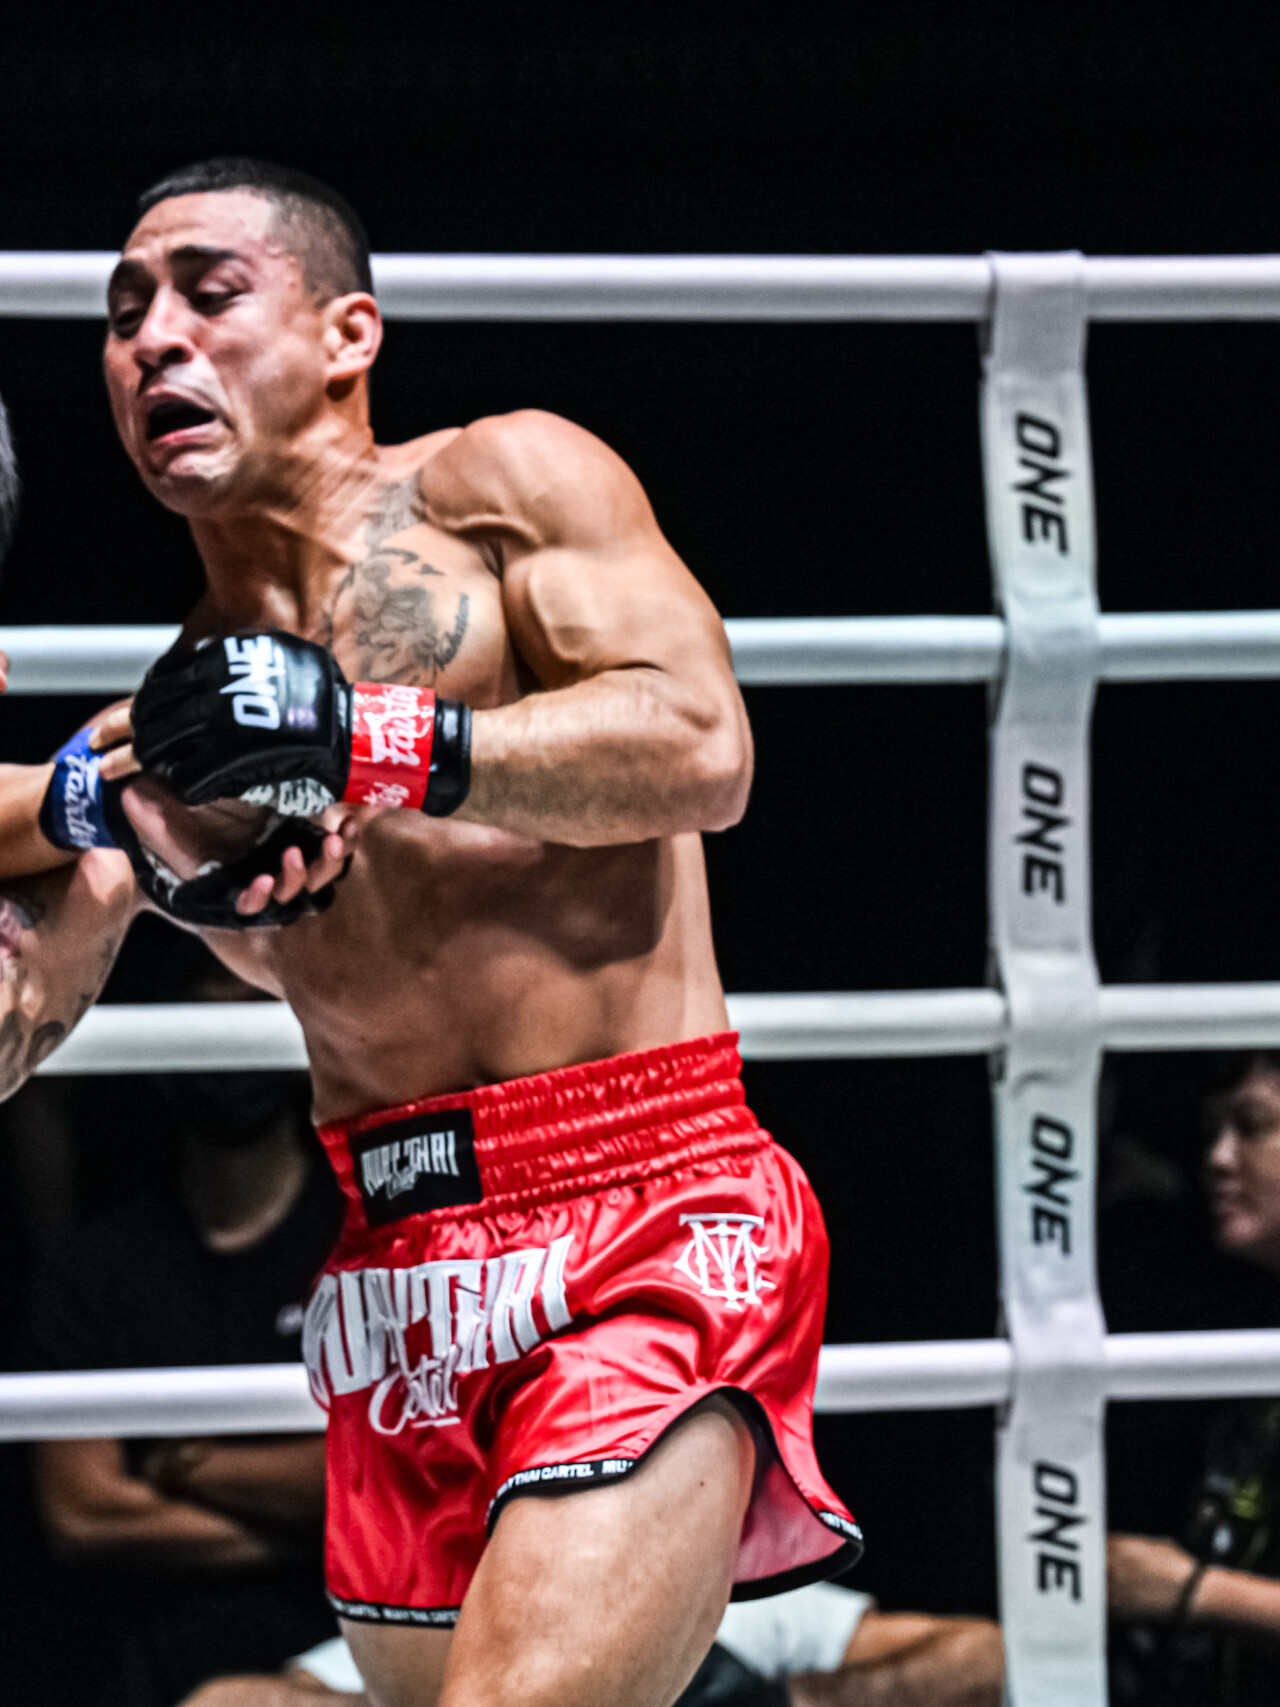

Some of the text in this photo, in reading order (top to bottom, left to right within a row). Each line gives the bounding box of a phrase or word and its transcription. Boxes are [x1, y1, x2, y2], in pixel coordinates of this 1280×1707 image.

[1011, 411, 1071, 556] ONE
[219, 634, 285, 731] ONE
[1014, 762, 1072, 905] ONE
[1020, 1112, 1081, 1258] ONE
[541, 1463, 594, 1481] CARTEL
[1028, 1460, 1089, 1602] ONE
